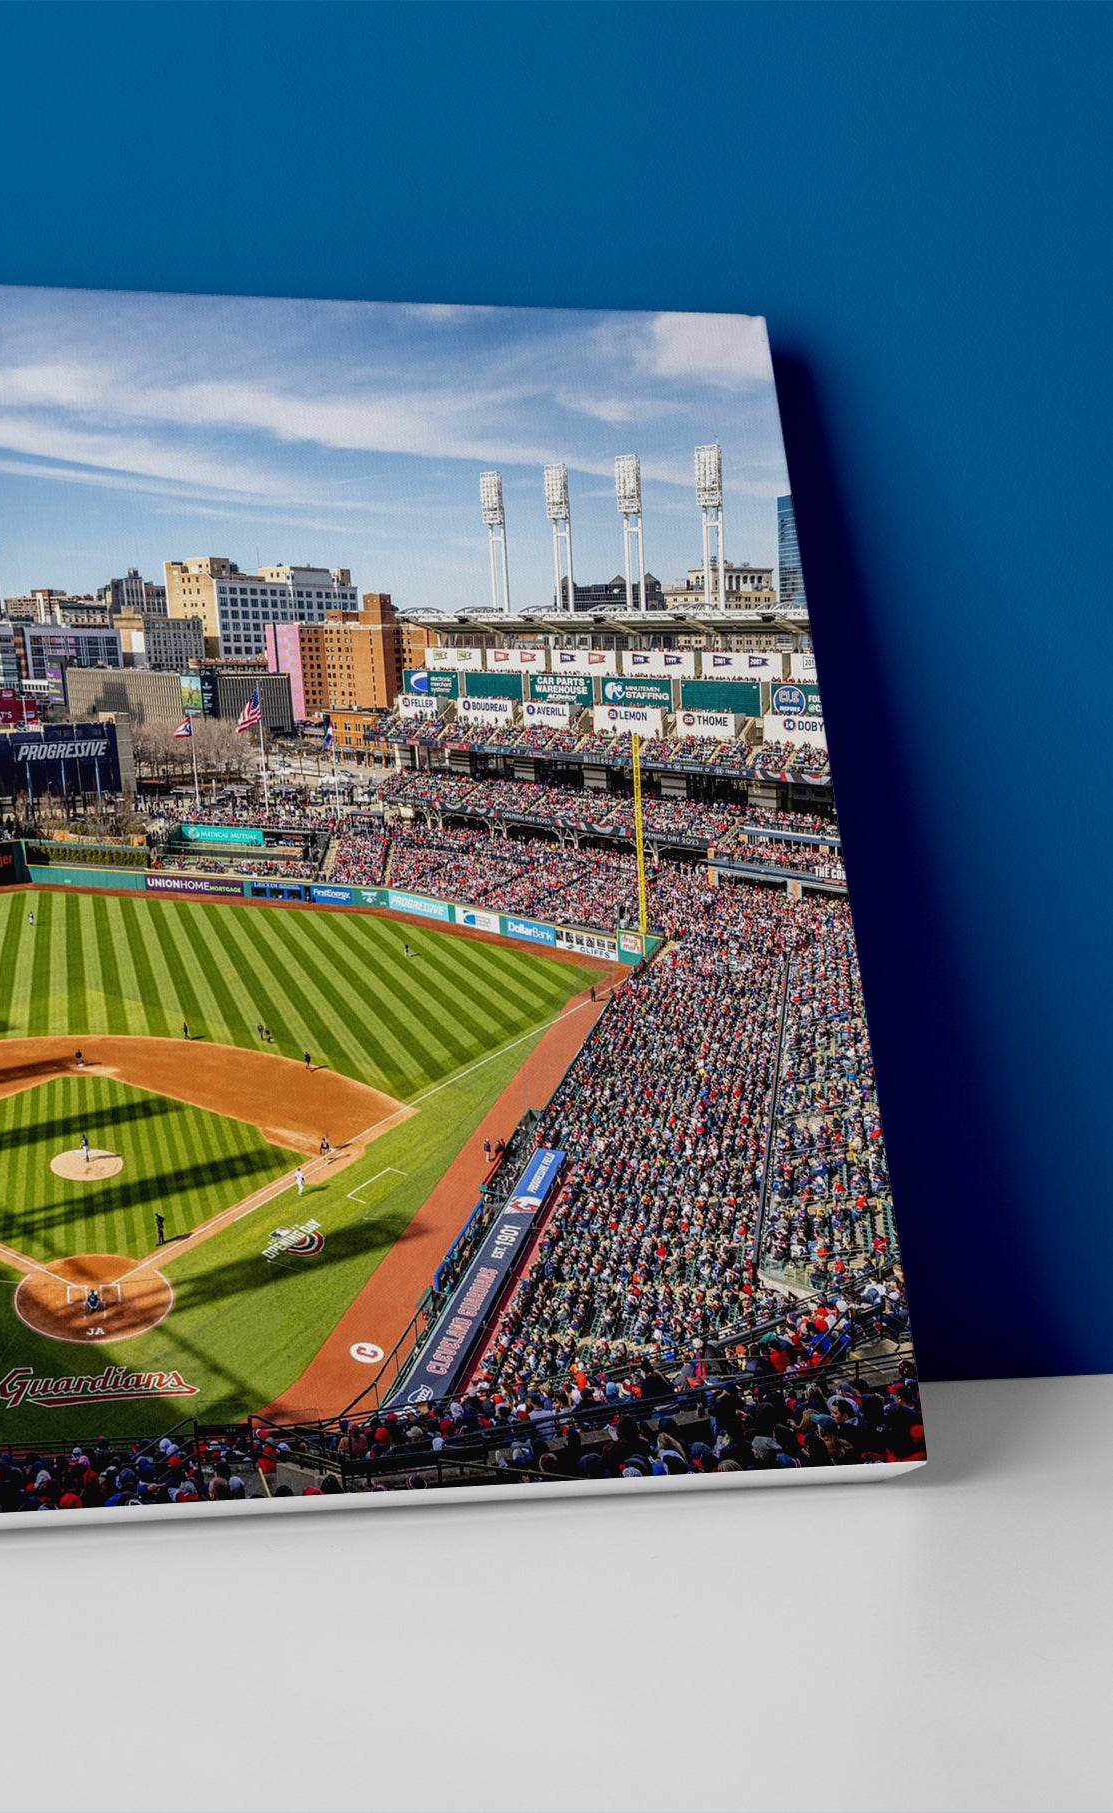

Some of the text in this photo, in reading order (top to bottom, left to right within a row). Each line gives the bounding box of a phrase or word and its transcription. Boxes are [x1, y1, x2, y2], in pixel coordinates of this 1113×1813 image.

[537, 676, 585, 686] CAR PARTS
[535, 684, 588, 695] WAREHOUSE
[625, 685, 660, 693] MINUTEMEN
[625, 691, 669, 701] STAFFING
[778, 690, 800, 704] CLE
[411, 698, 434, 708] FELLER
[472, 701, 508, 713] BOUDREAU
[536, 706, 567, 717] AVERILL
[619, 710, 648, 721] LEMON
[696, 715, 729, 727] THOME
[798, 720, 825, 732] DOBY
[17, 741, 107, 761] PROGRESSIVE
[200, 829, 258, 840] MEDICAL MUTUAL
[643, 832, 667, 841] PENING
[814, 865, 831, 878] THE
[390, 895, 446, 916] PROGRESSIVE
[508, 921, 554, 942] DollarBank
[579, 946, 611, 959] CLIFFS
[261, 1217, 322, 1260] OPENING DAY
[494, 1223, 522, 1252] 1901
[426, 1266, 499, 1376] CLEVELAND GUARDIANS
[86, 1327, 106, 1336] JA
